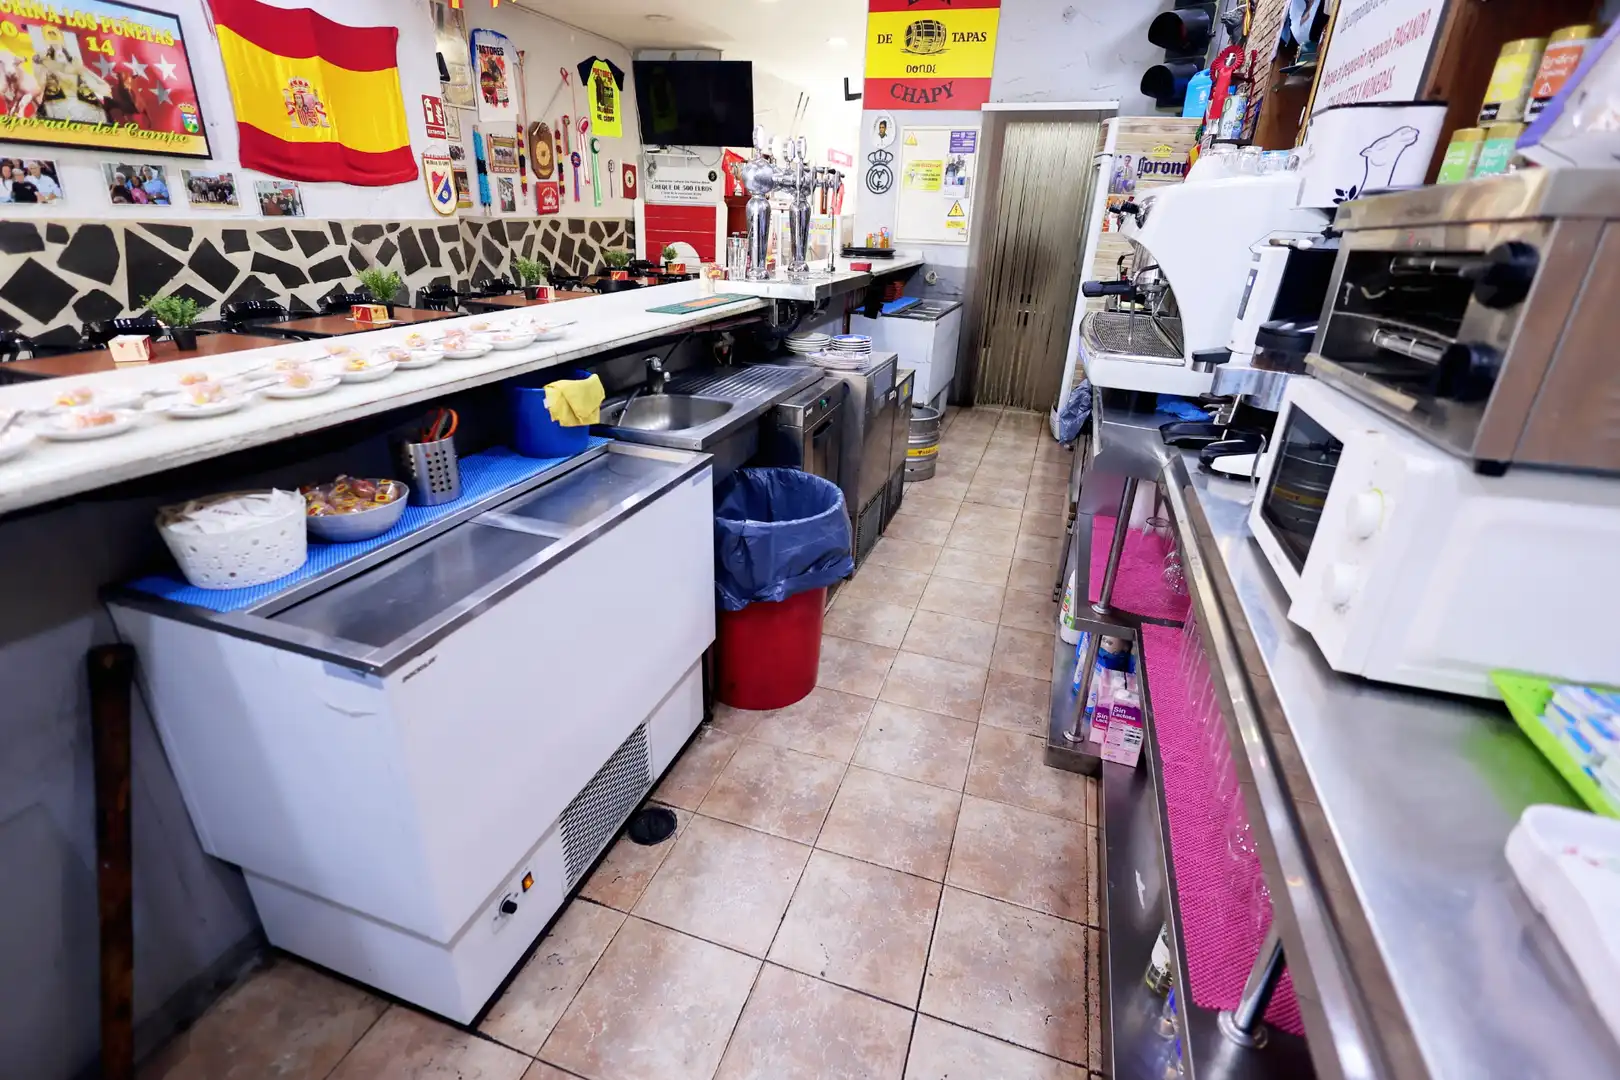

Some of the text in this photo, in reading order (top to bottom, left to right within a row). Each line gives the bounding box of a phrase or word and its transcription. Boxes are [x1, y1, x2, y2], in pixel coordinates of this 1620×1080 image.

[62, 7, 98, 31] LOS
[100, 14, 175, 47] PUÑETAS
[877, 32, 987, 44] DE TAPAS
[1391, 8, 1432, 50] PAGANDO
[86, 36, 115, 57] 14
[890, 80, 954, 104] CHAPY
[88, 121, 119, 136] del
[124, 121, 189, 144] Campo
[1112, 711, 1136, 720] Lactosa
[1113, 706, 1127, 715] Sin
